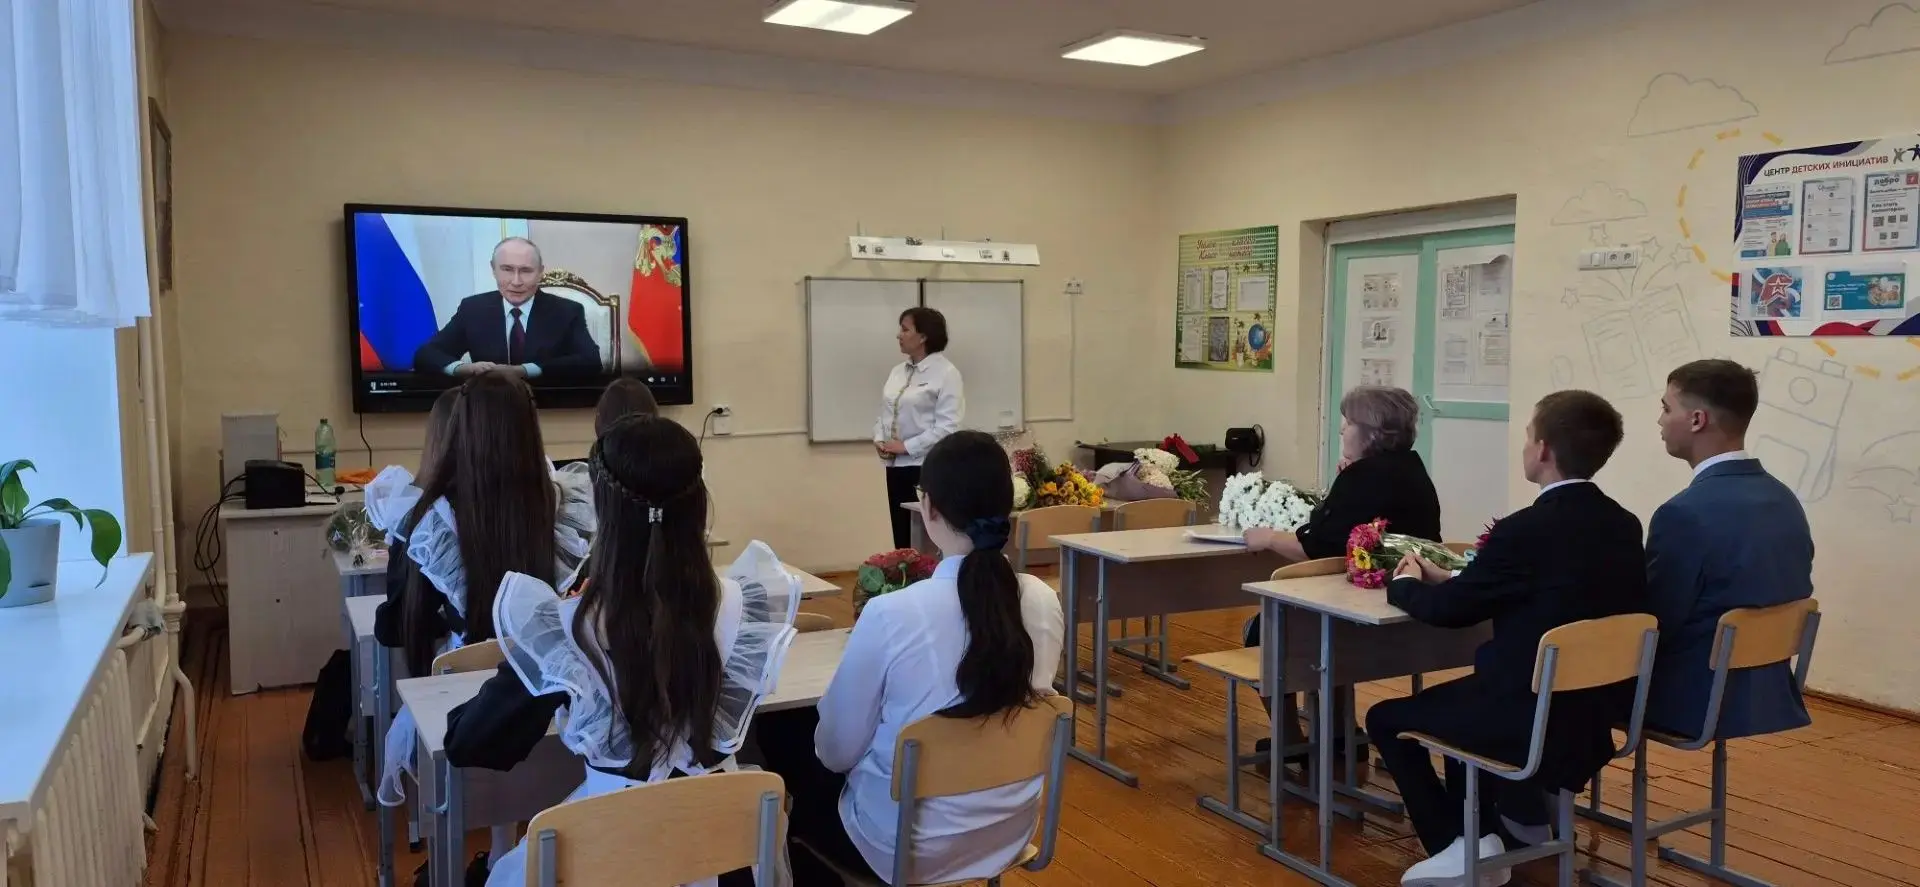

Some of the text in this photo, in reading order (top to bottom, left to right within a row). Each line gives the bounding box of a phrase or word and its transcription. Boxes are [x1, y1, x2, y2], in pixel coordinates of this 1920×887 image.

[1764, 155, 1889, 177] ЦЕНТР ДЕТСКИХ ИНИЦИАТИВ
